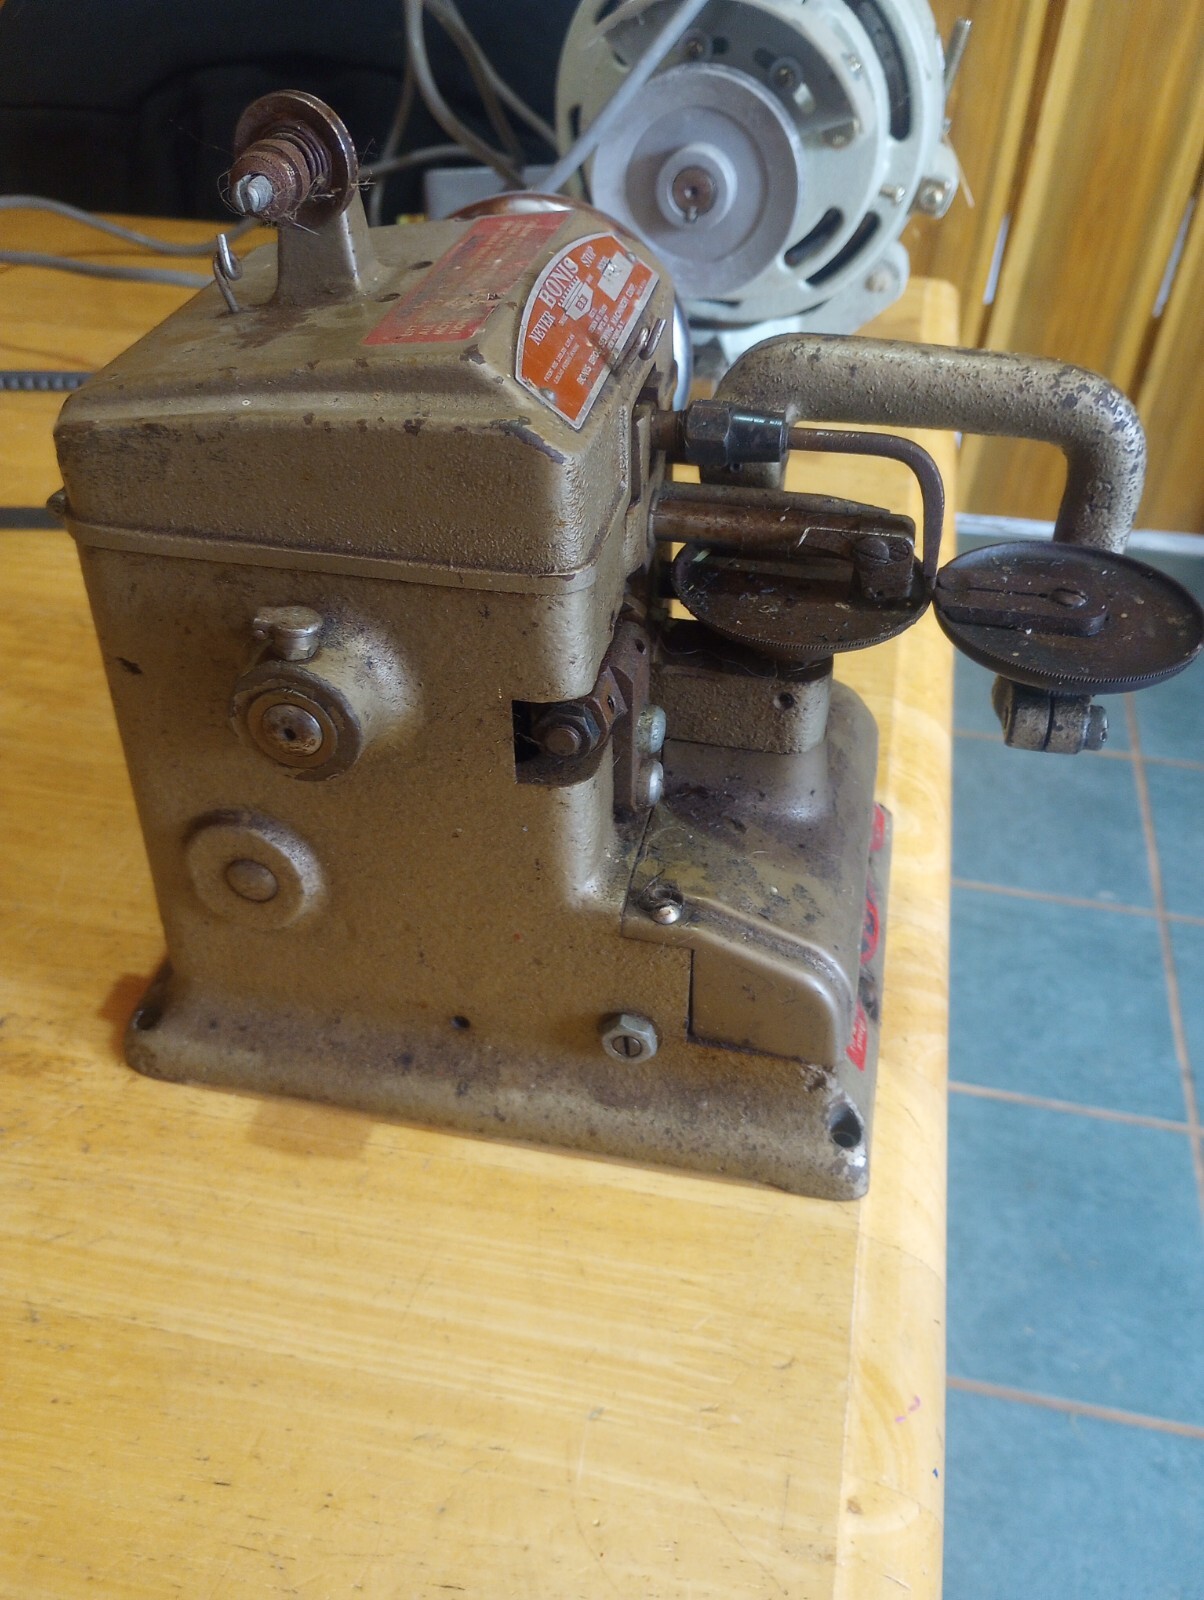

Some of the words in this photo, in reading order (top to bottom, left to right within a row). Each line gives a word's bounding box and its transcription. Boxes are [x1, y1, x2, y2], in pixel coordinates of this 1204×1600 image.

[581, 246, 596, 268] STOP
[540, 258, 578, 309] BONIS
[530, 311, 555, 345] NEVER
[575, 363, 592, 386] BONIS
